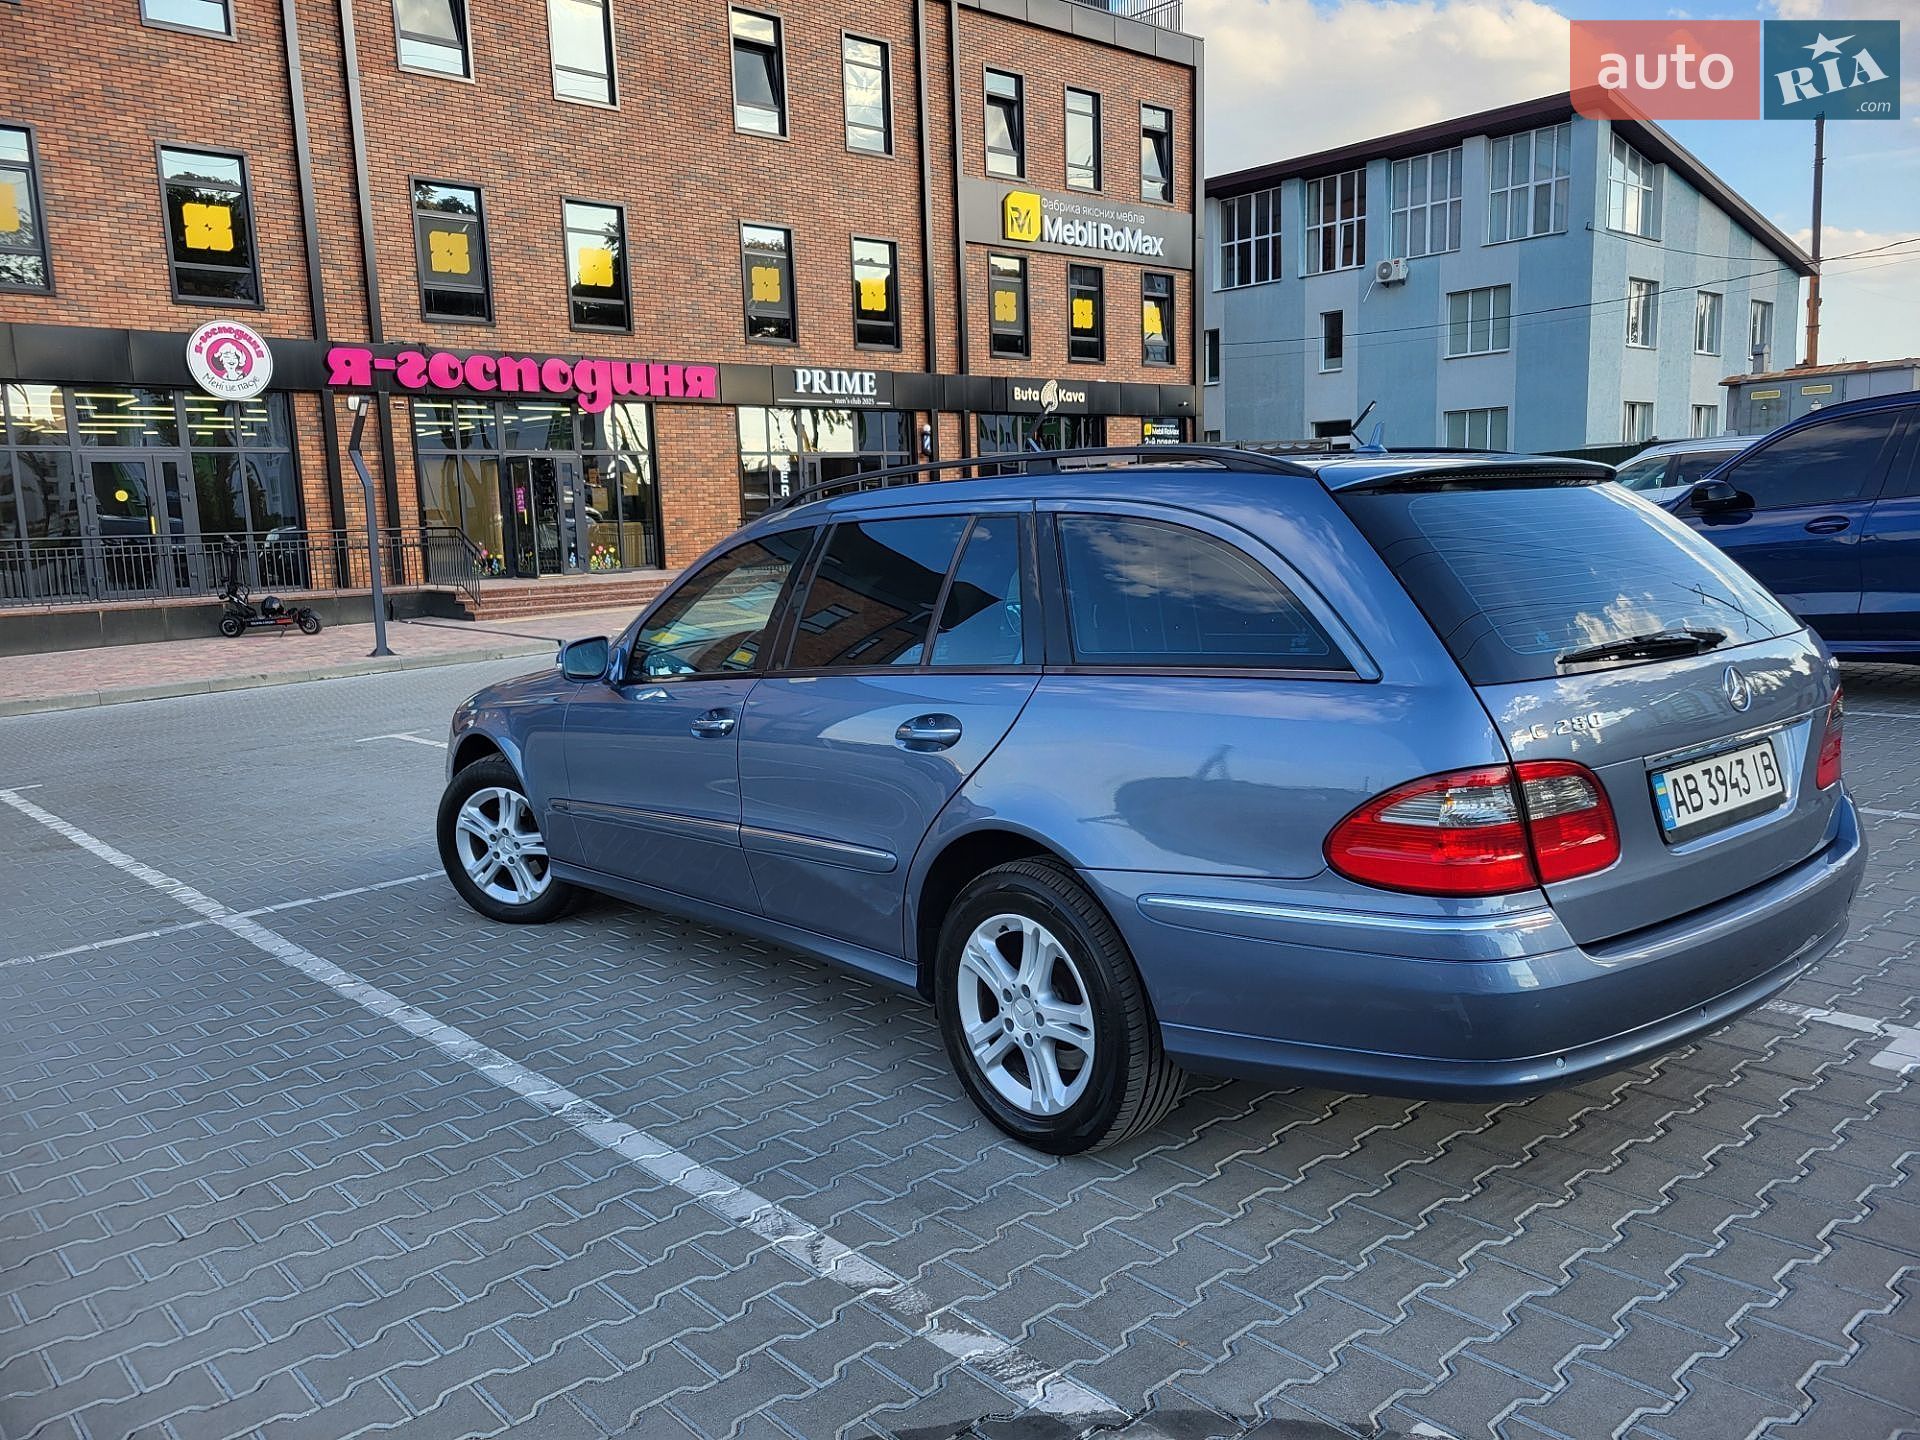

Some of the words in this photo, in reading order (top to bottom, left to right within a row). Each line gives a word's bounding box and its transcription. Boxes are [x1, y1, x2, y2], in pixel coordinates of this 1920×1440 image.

[1041, 197, 1085, 215] Фабрика
[1081, 206, 1116, 220] якісних
[1117, 211, 1145, 224] меблів
[202, 372, 224, 391] Мені
[225, 384, 237, 392] це
[794, 368, 877, 396] PRIME
[1013, 386, 1040, 401] Buta
[1058, 388, 1086, 403] Kava
[1554, 713, 1602, 736] 280
[1671, 773, 1704, 818] AB
[1701, 758, 1751, 806] 3943
[1752, 750, 1777, 790] IB
[1661, 808, 1675, 821] UA
